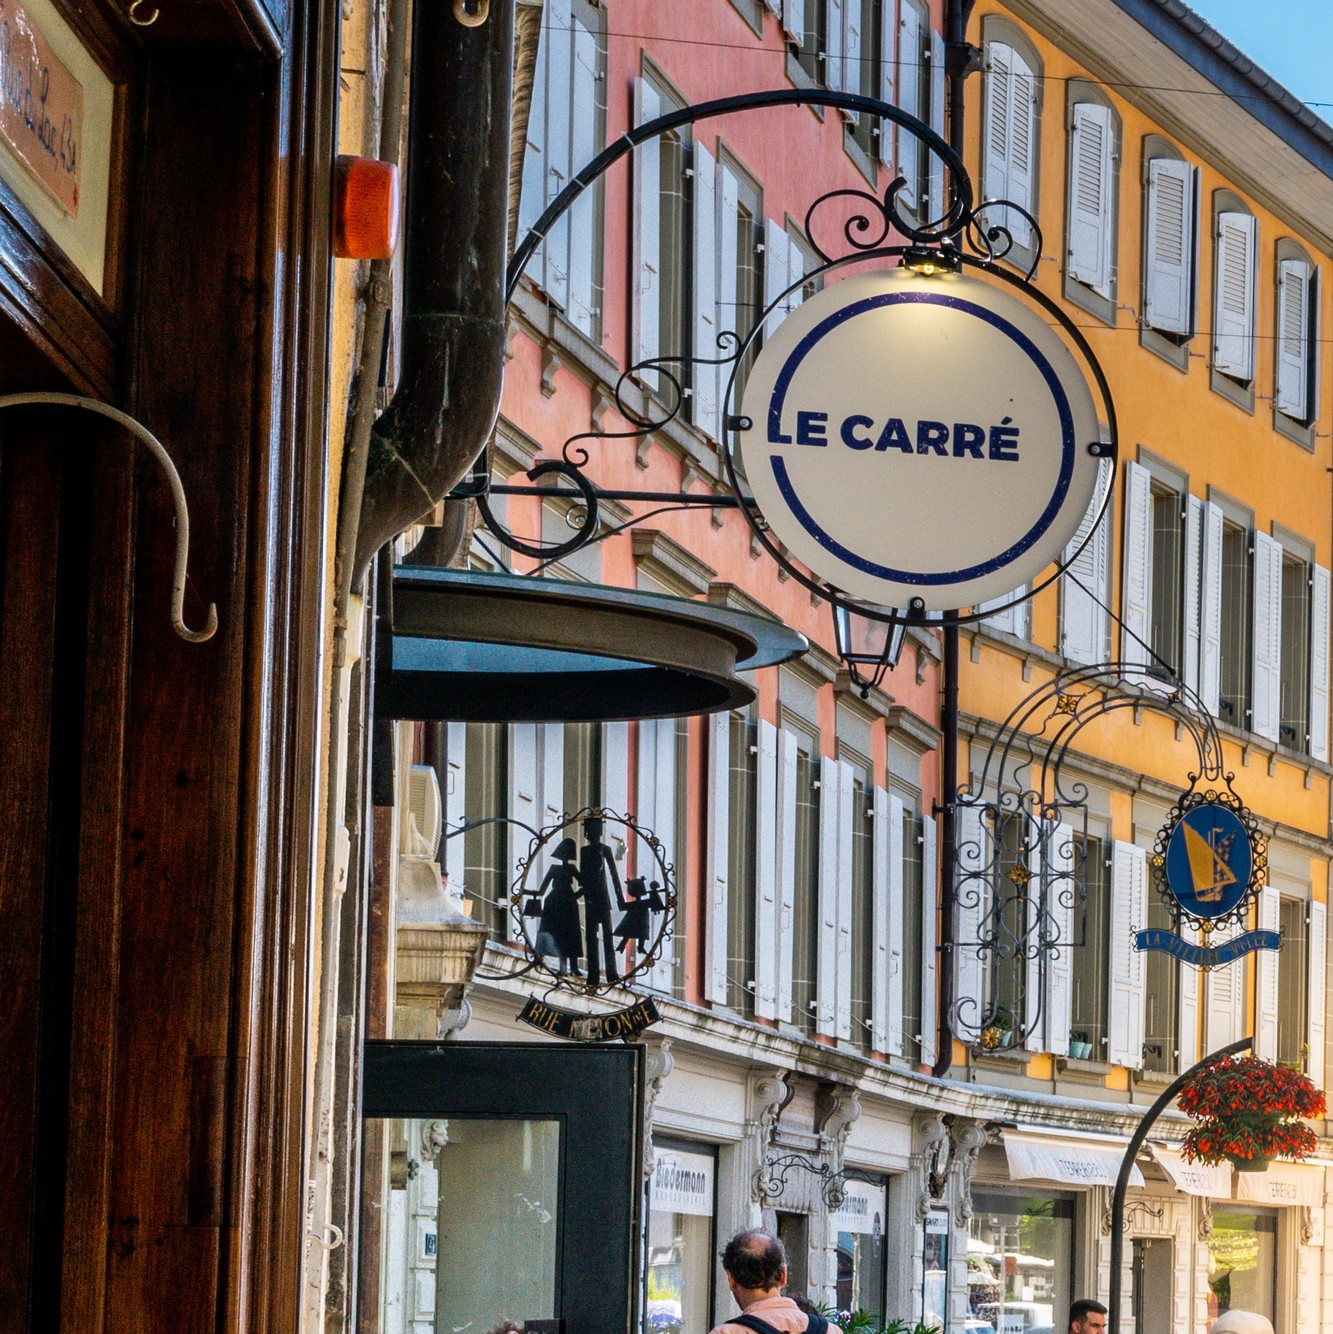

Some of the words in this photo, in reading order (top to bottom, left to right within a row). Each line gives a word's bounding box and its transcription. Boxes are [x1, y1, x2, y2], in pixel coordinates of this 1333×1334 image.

[767, 410, 828, 447] LE
[840, 416, 1020, 462] CARRÉ
[529, 1002, 563, 1033] RUE
[655, 1157, 706, 1194] Biedermann
